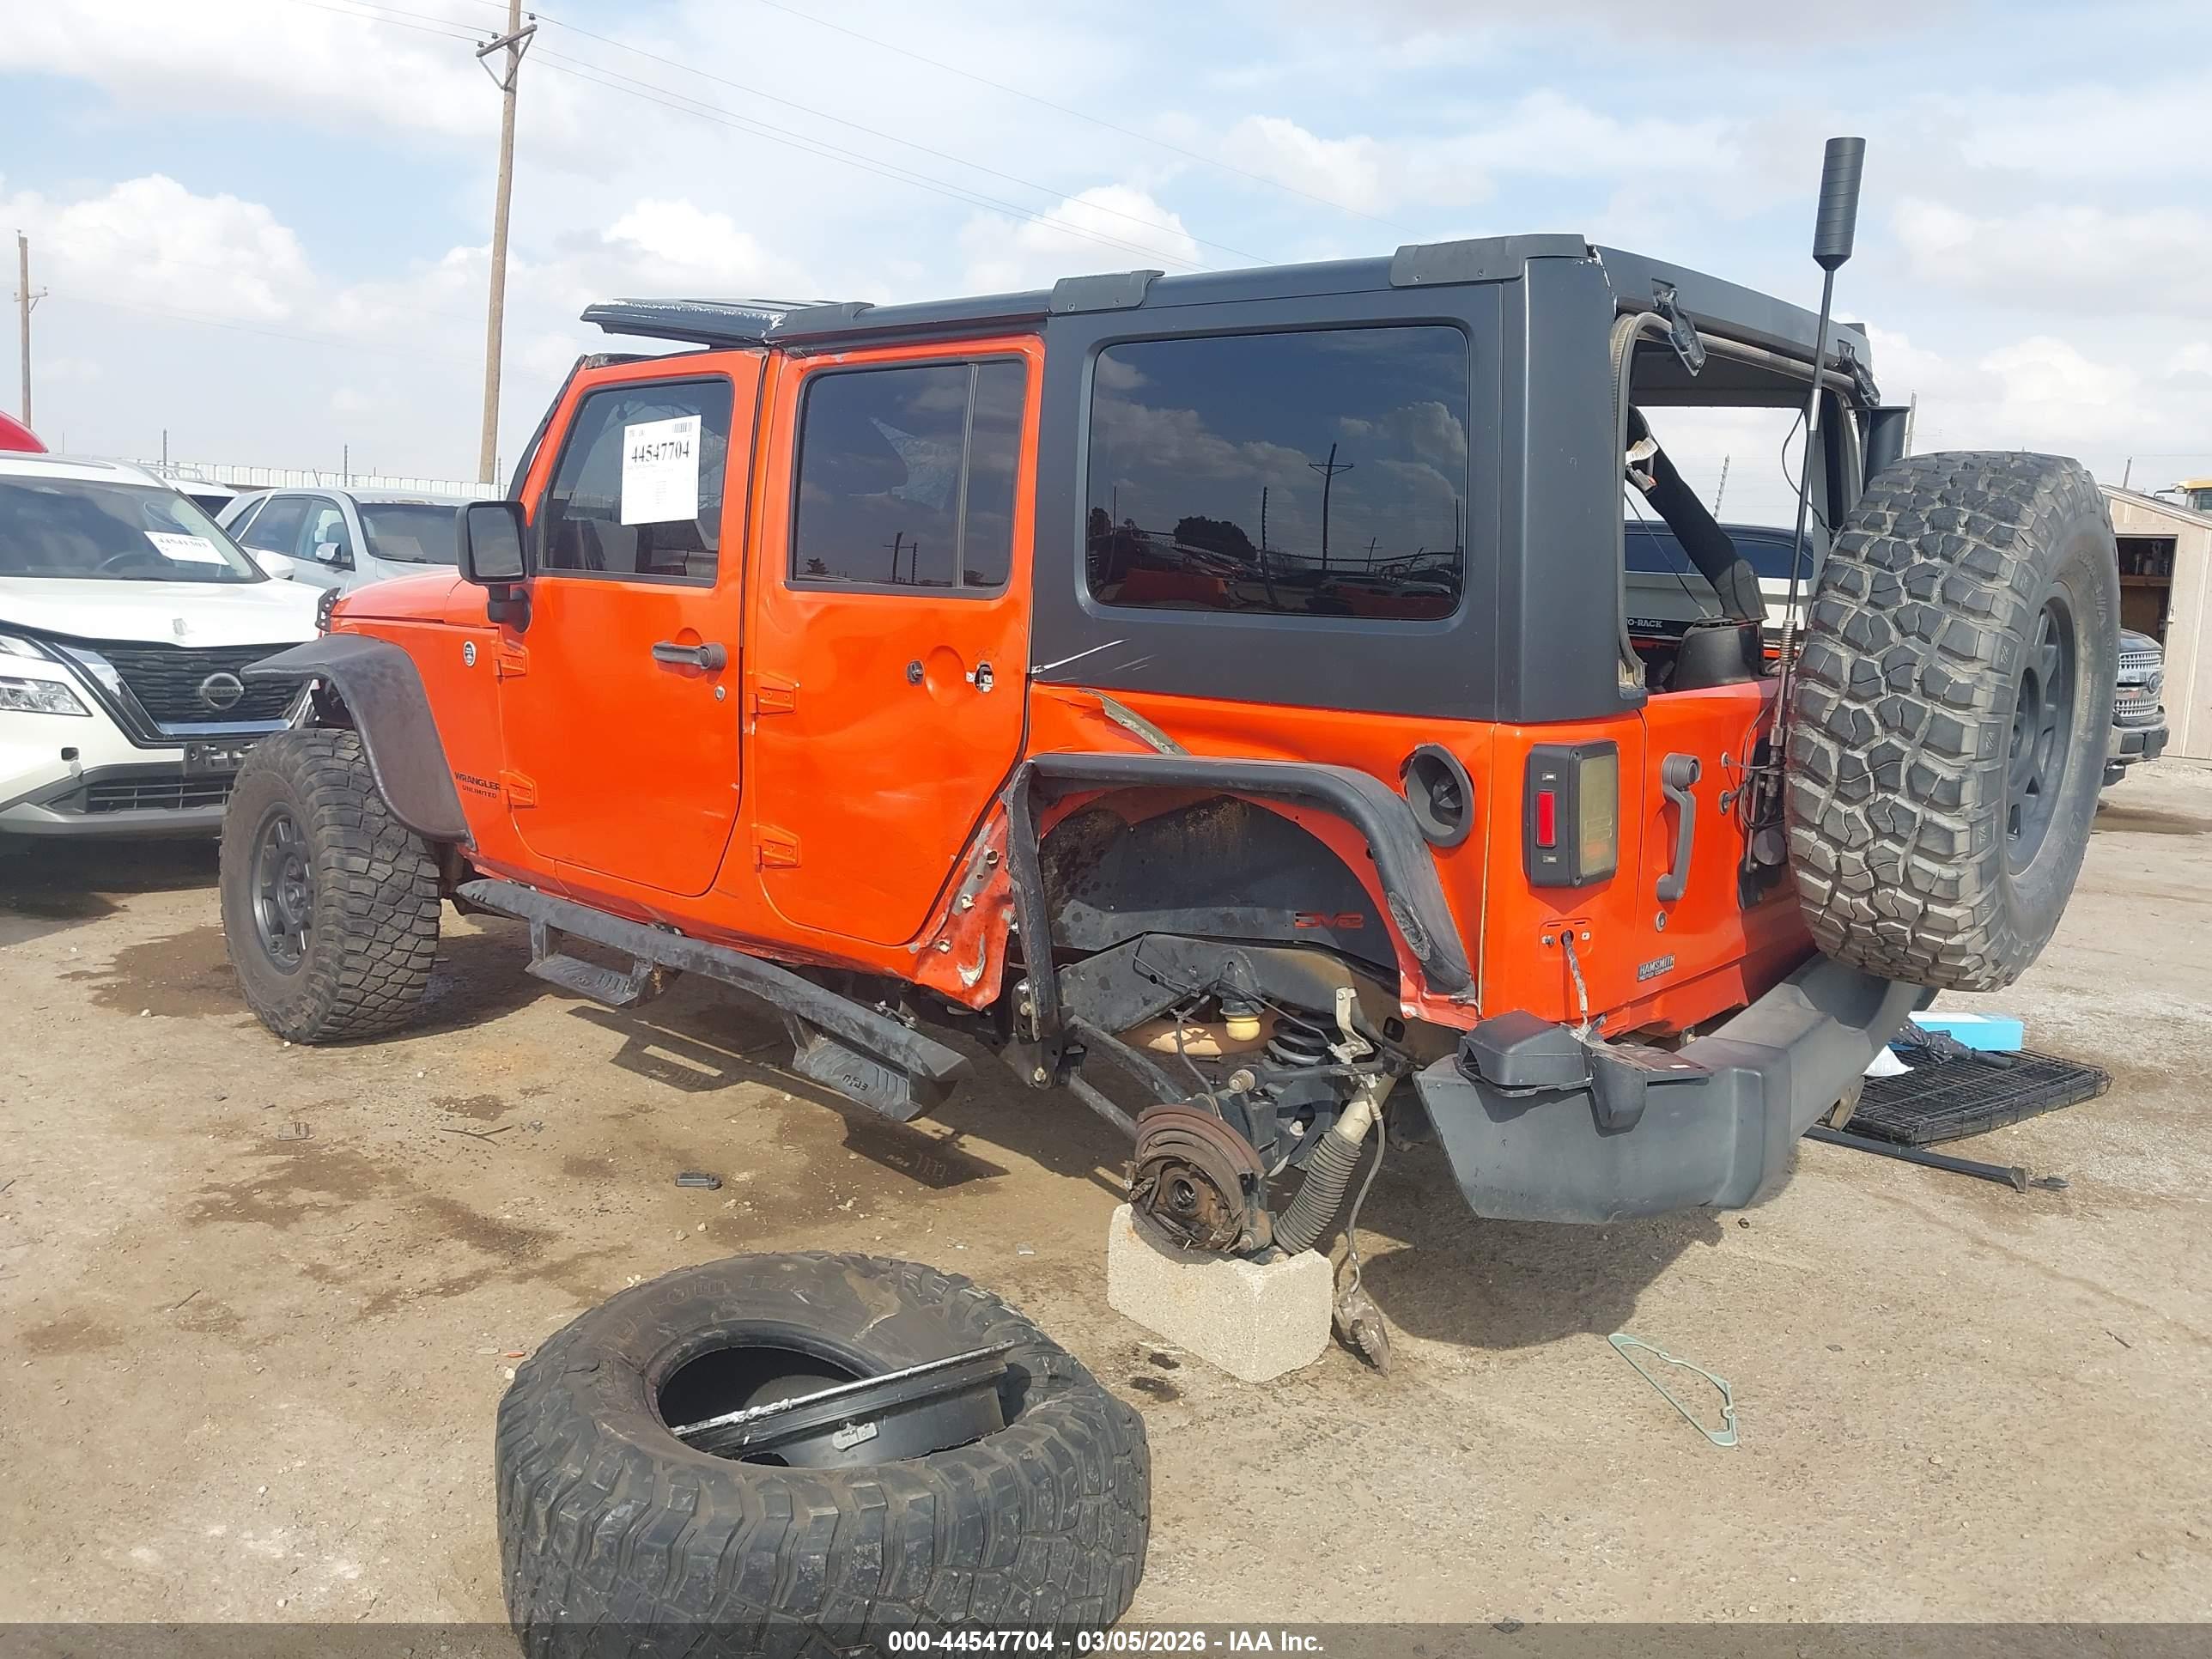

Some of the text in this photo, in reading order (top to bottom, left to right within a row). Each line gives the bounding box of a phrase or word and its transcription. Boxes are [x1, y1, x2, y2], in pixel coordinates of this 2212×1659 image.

[631, 439, 690, 464] 44547704
[454, 771, 501, 791] WRANGLER
[462, 784, 497, 799] UNLIMITED
[1639, 954, 1675, 976] HAMSMITH
